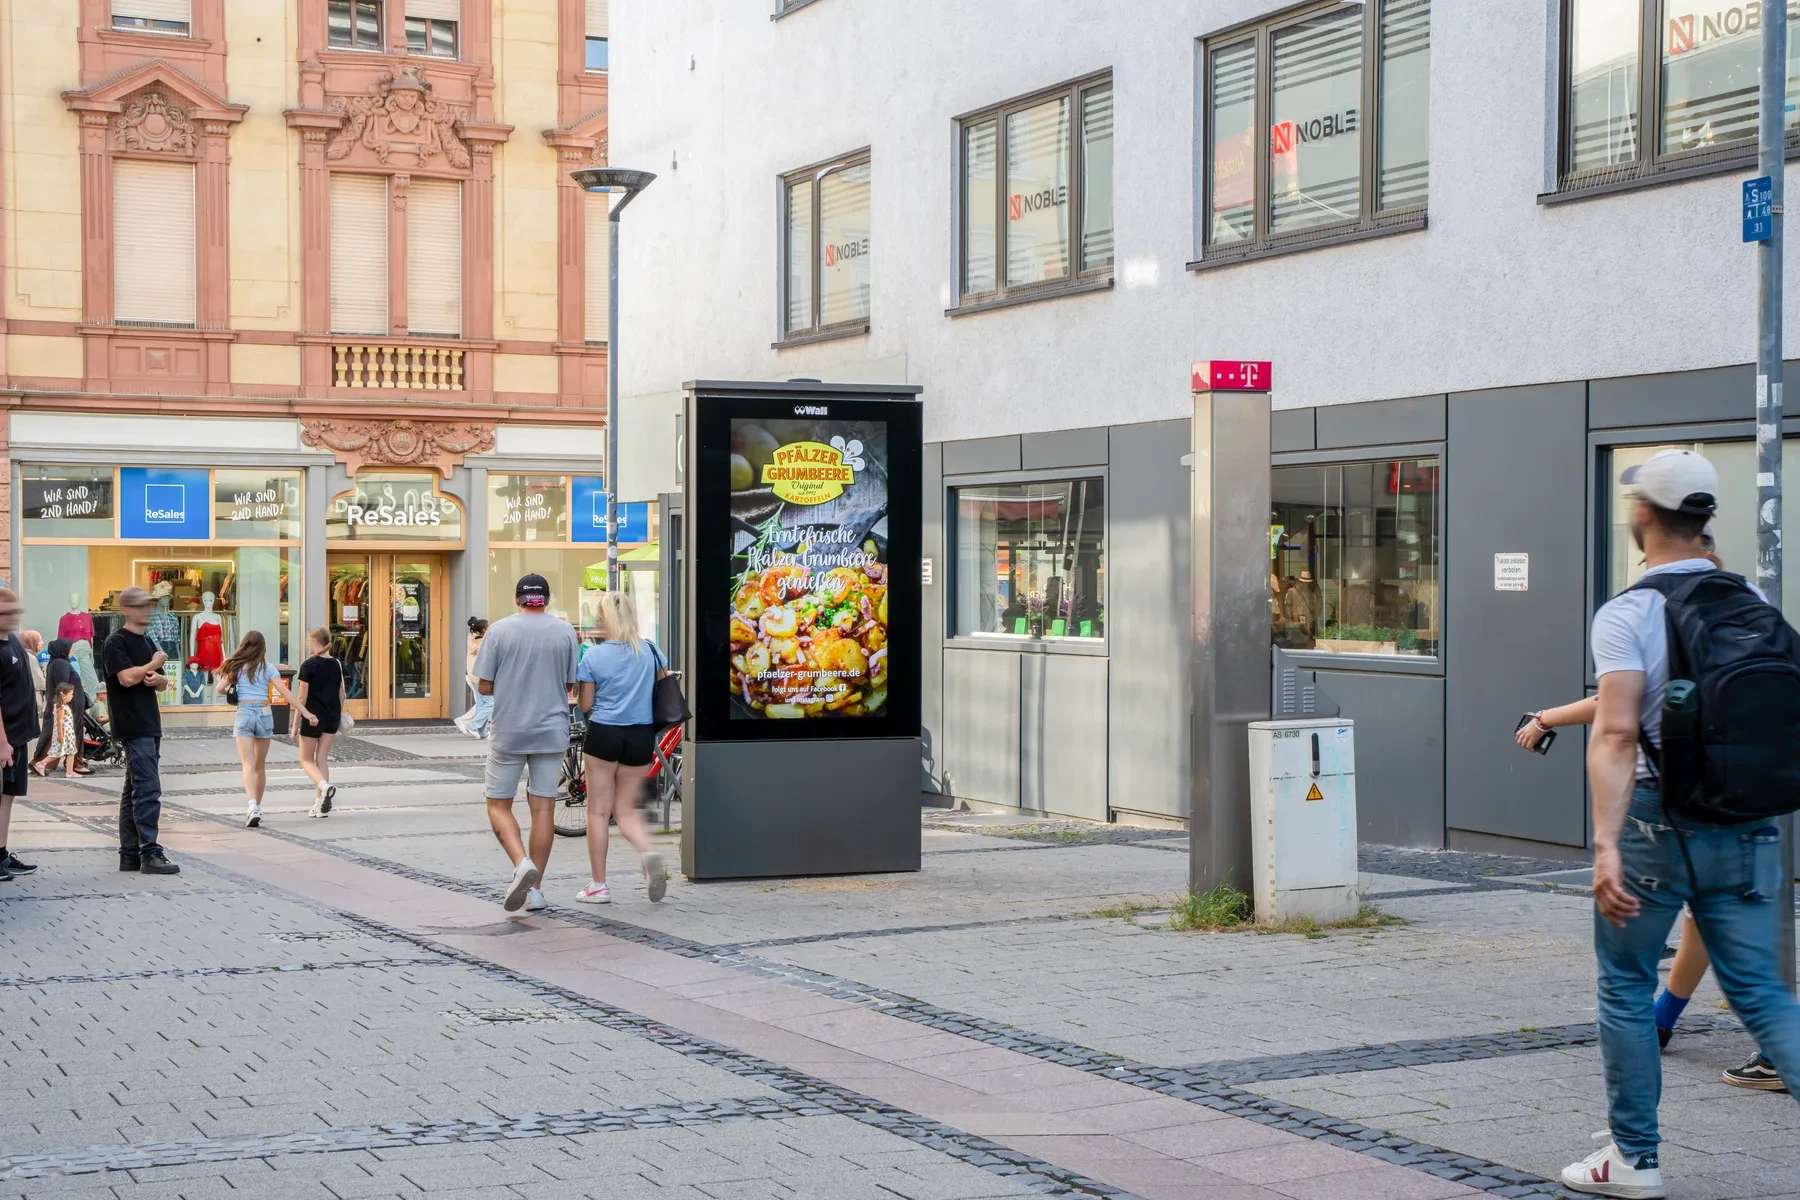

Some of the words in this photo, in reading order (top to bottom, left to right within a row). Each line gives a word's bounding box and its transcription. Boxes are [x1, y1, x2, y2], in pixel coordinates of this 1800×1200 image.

[1296, 109, 1356, 144] NOBLE
[1025, 185, 1066, 214] NOBLE
[837, 238, 868, 261] NOBLE
[805, 405, 828, 416] Wall
[776, 445, 839, 467] PFÄLZER
[766, 467, 850, 481] GRUMBEERE
[43, 488, 63, 503] WIR
[66, 485, 89, 501] SIND
[791, 480, 825, 491] Original
[234, 492, 252, 506] WIR
[255, 489, 276, 503] SIND
[505, 496, 522, 510] WIR
[524, 493, 544, 506] SIND
[785, 492, 831, 504] KARTOFFELN
[40, 504, 63, 519] 2ND
[66, 500, 98, 517] HAND!
[146, 509, 184, 519] ReSales
[231, 507, 251, 521] 2ND
[255, 502, 285, 518] HAND!
[347, 504, 441, 526] ReSales
[503, 511, 522, 525] 2ND
[524, 506, 552, 522] HAND!
[767, 523, 857, 553] Erntefrische
[747, 546, 800, 574] Pfälzer
[802, 547, 877, 568] Grumbeere
[777, 571, 846, 600] genießen
[757, 668, 861, 681] pfaelzer-grumbeere.de
[771, 686, 786, 694] folgt
[1284, 730, 1300, 739] 6730
